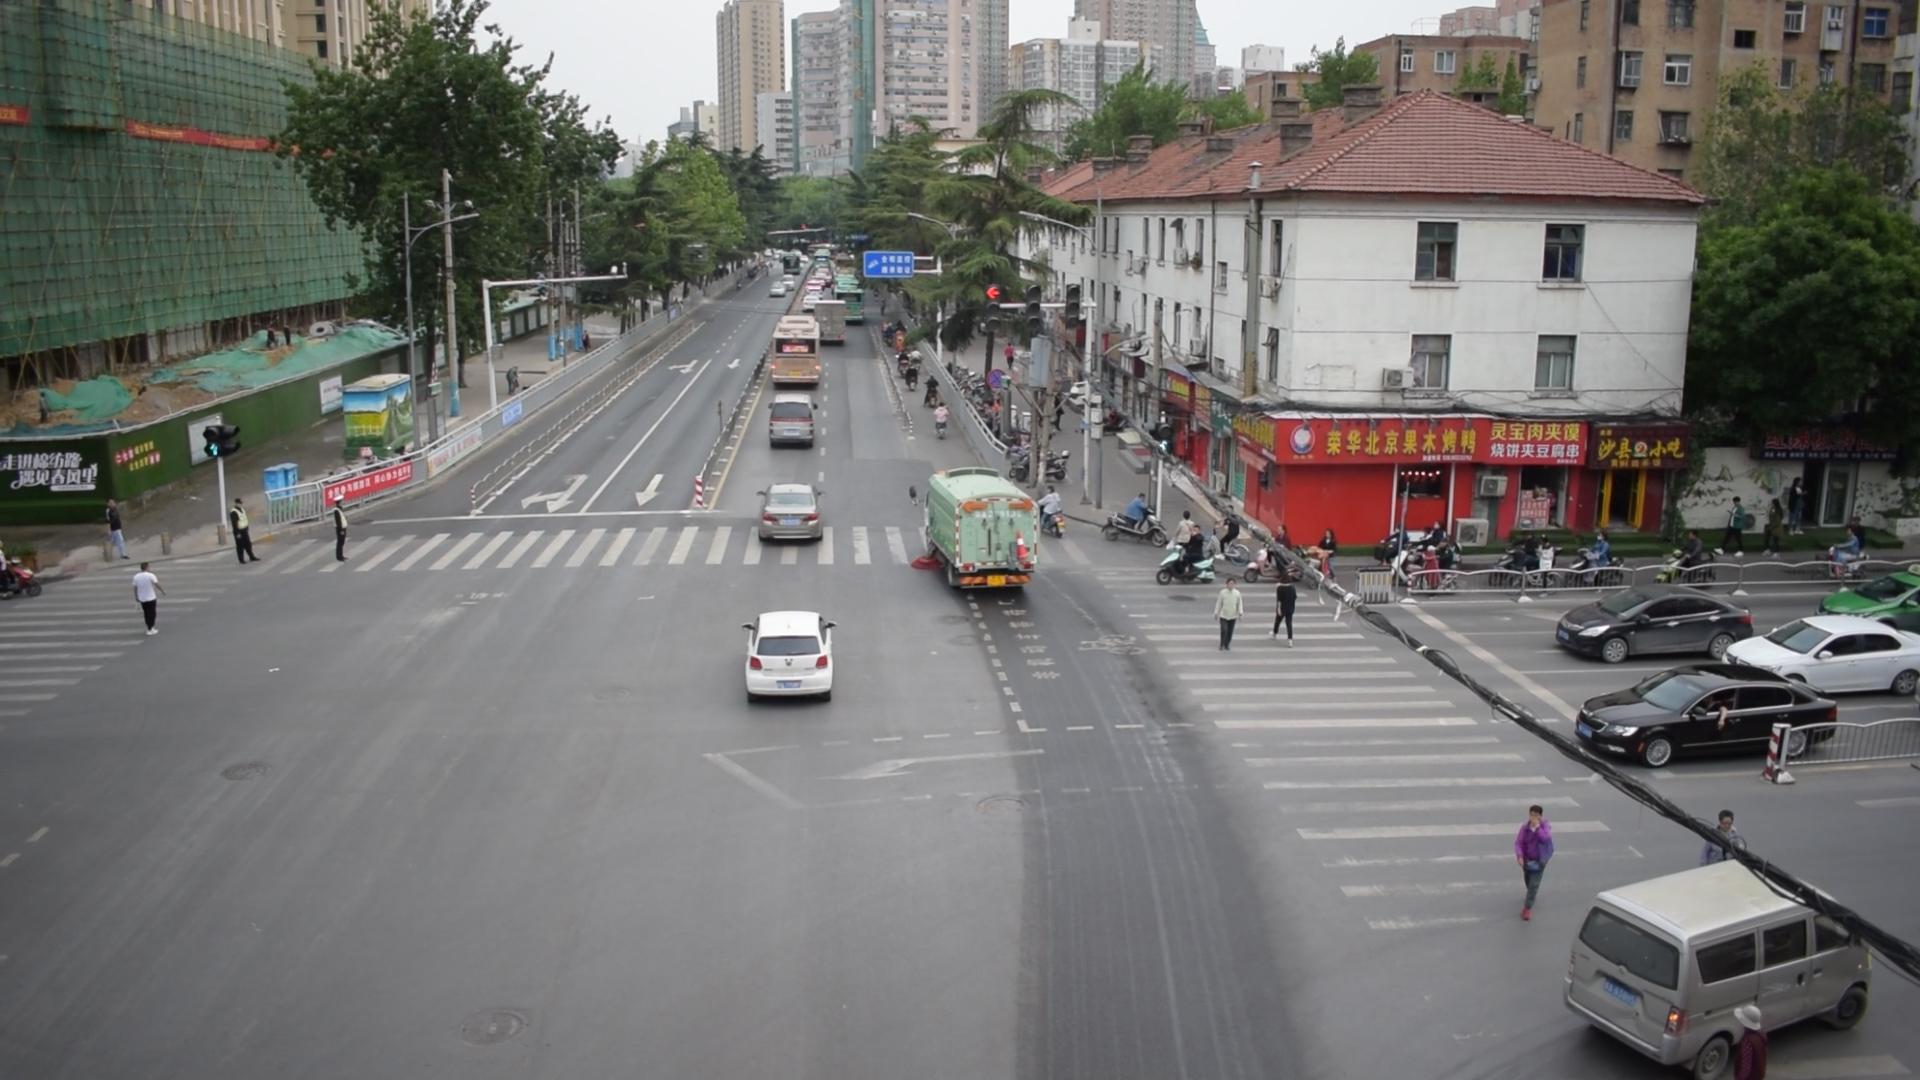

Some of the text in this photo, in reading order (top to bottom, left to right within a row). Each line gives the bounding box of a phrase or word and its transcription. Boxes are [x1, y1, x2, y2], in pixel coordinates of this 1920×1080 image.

[1326, 428, 1477, 456] 荣华北京果木烤鸭
[1490, 422, 1580, 441] 灵宝肉夹馍
[1490, 443, 1579, 459] 烧饼夹豆腐串
[1598, 437, 1684, 461] 沙县小吃
